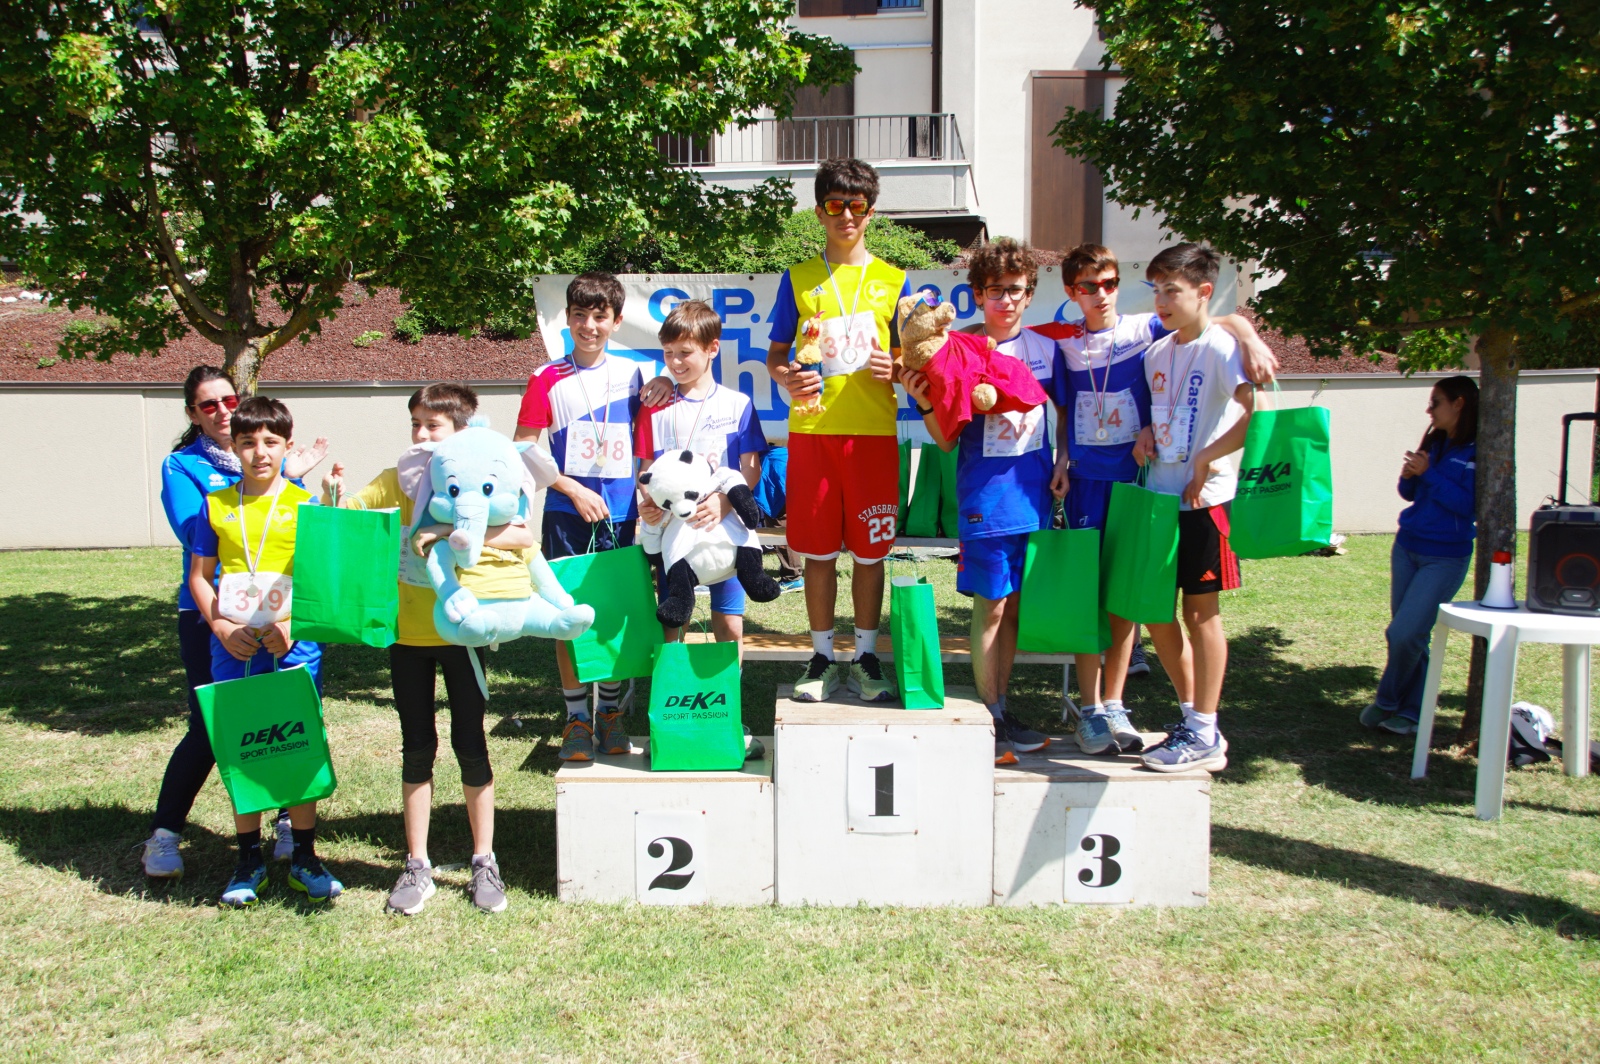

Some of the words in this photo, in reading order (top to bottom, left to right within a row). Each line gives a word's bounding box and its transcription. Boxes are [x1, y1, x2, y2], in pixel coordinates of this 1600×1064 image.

[580, 438, 625, 461] 318
[1259, 482, 1292, 495] PASSION
[858, 504, 899, 522] STARSBRU
[868, 516, 896, 545] 23
[235, 589, 283, 612] 319
[664, 691, 727, 711] DEKA
[662, 713, 690, 721] SPORT
[692, 711, 729, 720] PASSION
[240, 720, 305, 747] DEKA
[240, 747, 269, 760] SPORT
[270, 739, 309, 754] PASSION
[868, 763, 900, 817] 1
[647, 836, 695, 891] 2
[1078, 833, 1122, 888] 3
